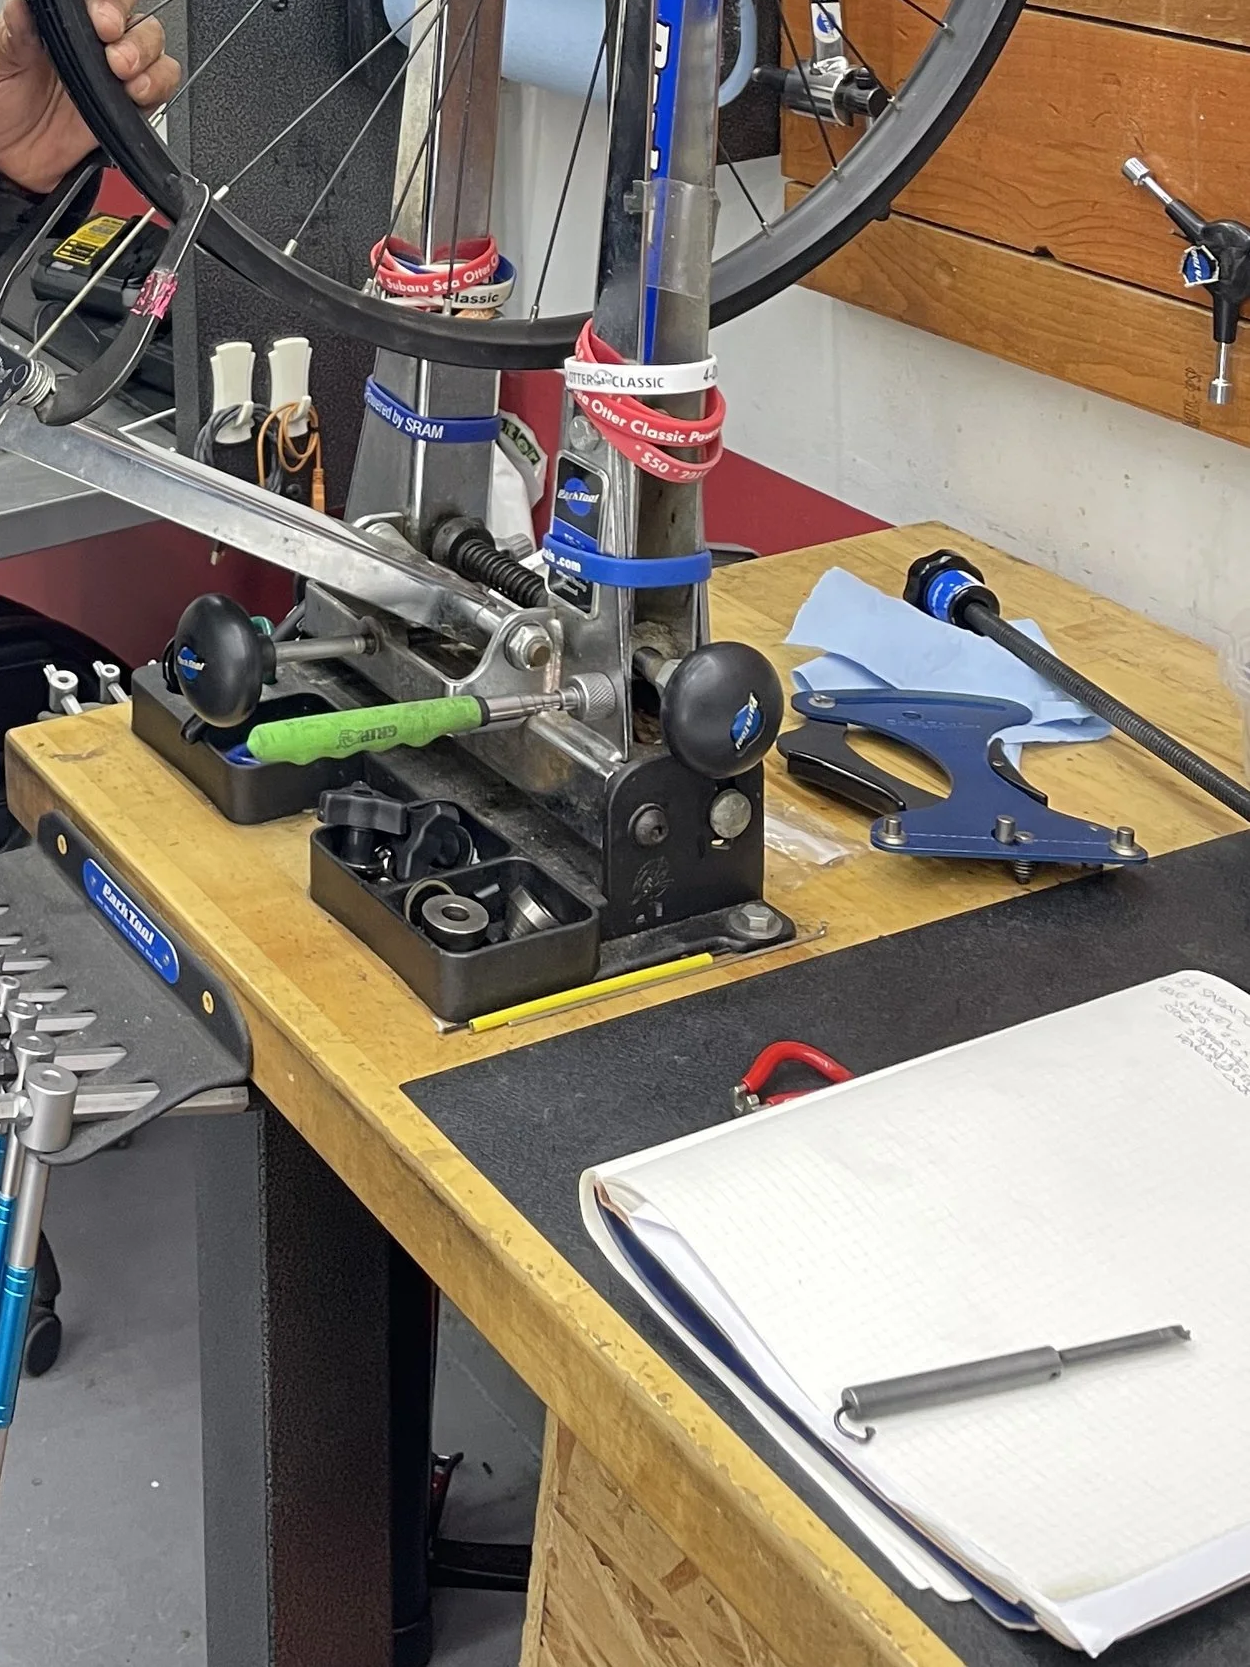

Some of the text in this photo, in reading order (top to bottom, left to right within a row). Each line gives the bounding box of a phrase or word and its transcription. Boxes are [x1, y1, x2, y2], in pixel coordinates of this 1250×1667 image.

[387, 278, 429, 293] Subaru
[463, 264, 491, 284] Otter
[612, 376, 664, 389] CLASSIC
[392, 409, 405, 429] by
[405, 417, 444, 439] SRAM
[591, 400, 627, 427] Otter
[630, 419, 686, 443] Classic
